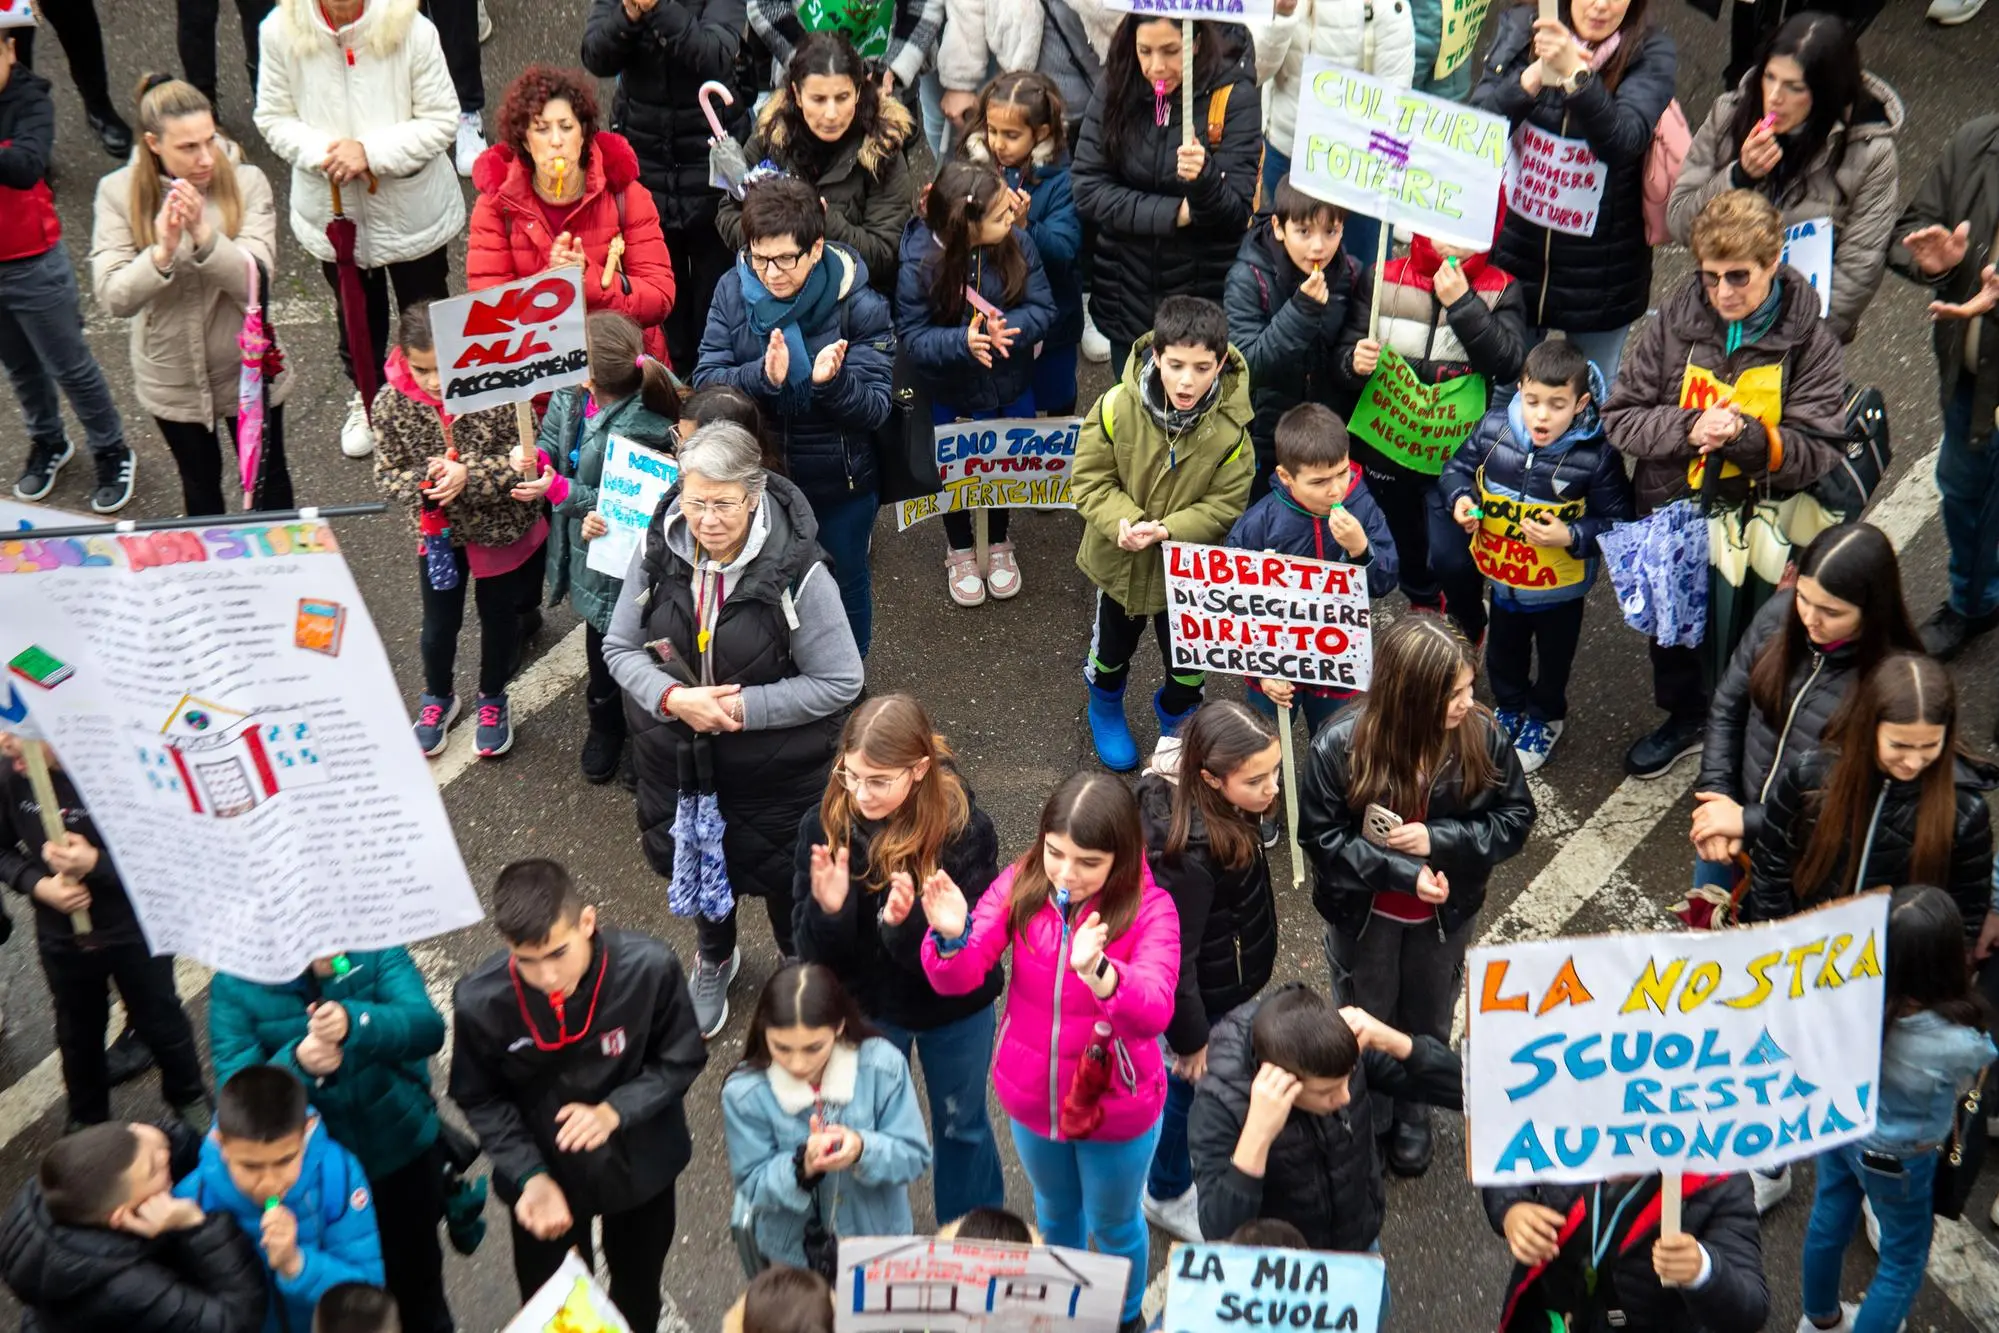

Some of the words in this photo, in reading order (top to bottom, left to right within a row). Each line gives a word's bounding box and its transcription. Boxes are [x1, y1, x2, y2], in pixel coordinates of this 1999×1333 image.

[1313, 70, 1505, 168] CULTURA
[1523, 128, 1555, 158] NON
[1306, 134, 1462, 219] POTERE
[1512, 186, 1594, 232] FUTURO!
[463, 278, 576, 337] NO
[1382, 350, 1441, 404] SCUOLE
[1370, 416, 1451, 462] NEGATE
[964, 457, 1066, 476] FUTURO
[903, 493, 940, 526] PER
[1169, 547, 1356, 594] LIBERTA'
[1174, 588, 1197, 607] DI
[1203, 589, 1370, 629] SCEGLIERE
[1181, 613, 1349, 655] DIRITTO
[1175, 646, 1201, 665] DI
[1206, 647, 1356, 685] CRESCERE
[1480, 955, 1595, 1017] LA
[1618, 928, 1882, 1016] NOSTRA
[1504, 1023, 1791, 1103] SCUOLA
[1623, 1070, 1821, 1115] RESTA
[1494, 1081, 1871, 1174] AUTONOMA!
[1178, 1246, 1225, 1283] LA
[1251, 1255, 1328, 1294] MIA
[1215, 1291, 1358, 1331] SCUOLA
